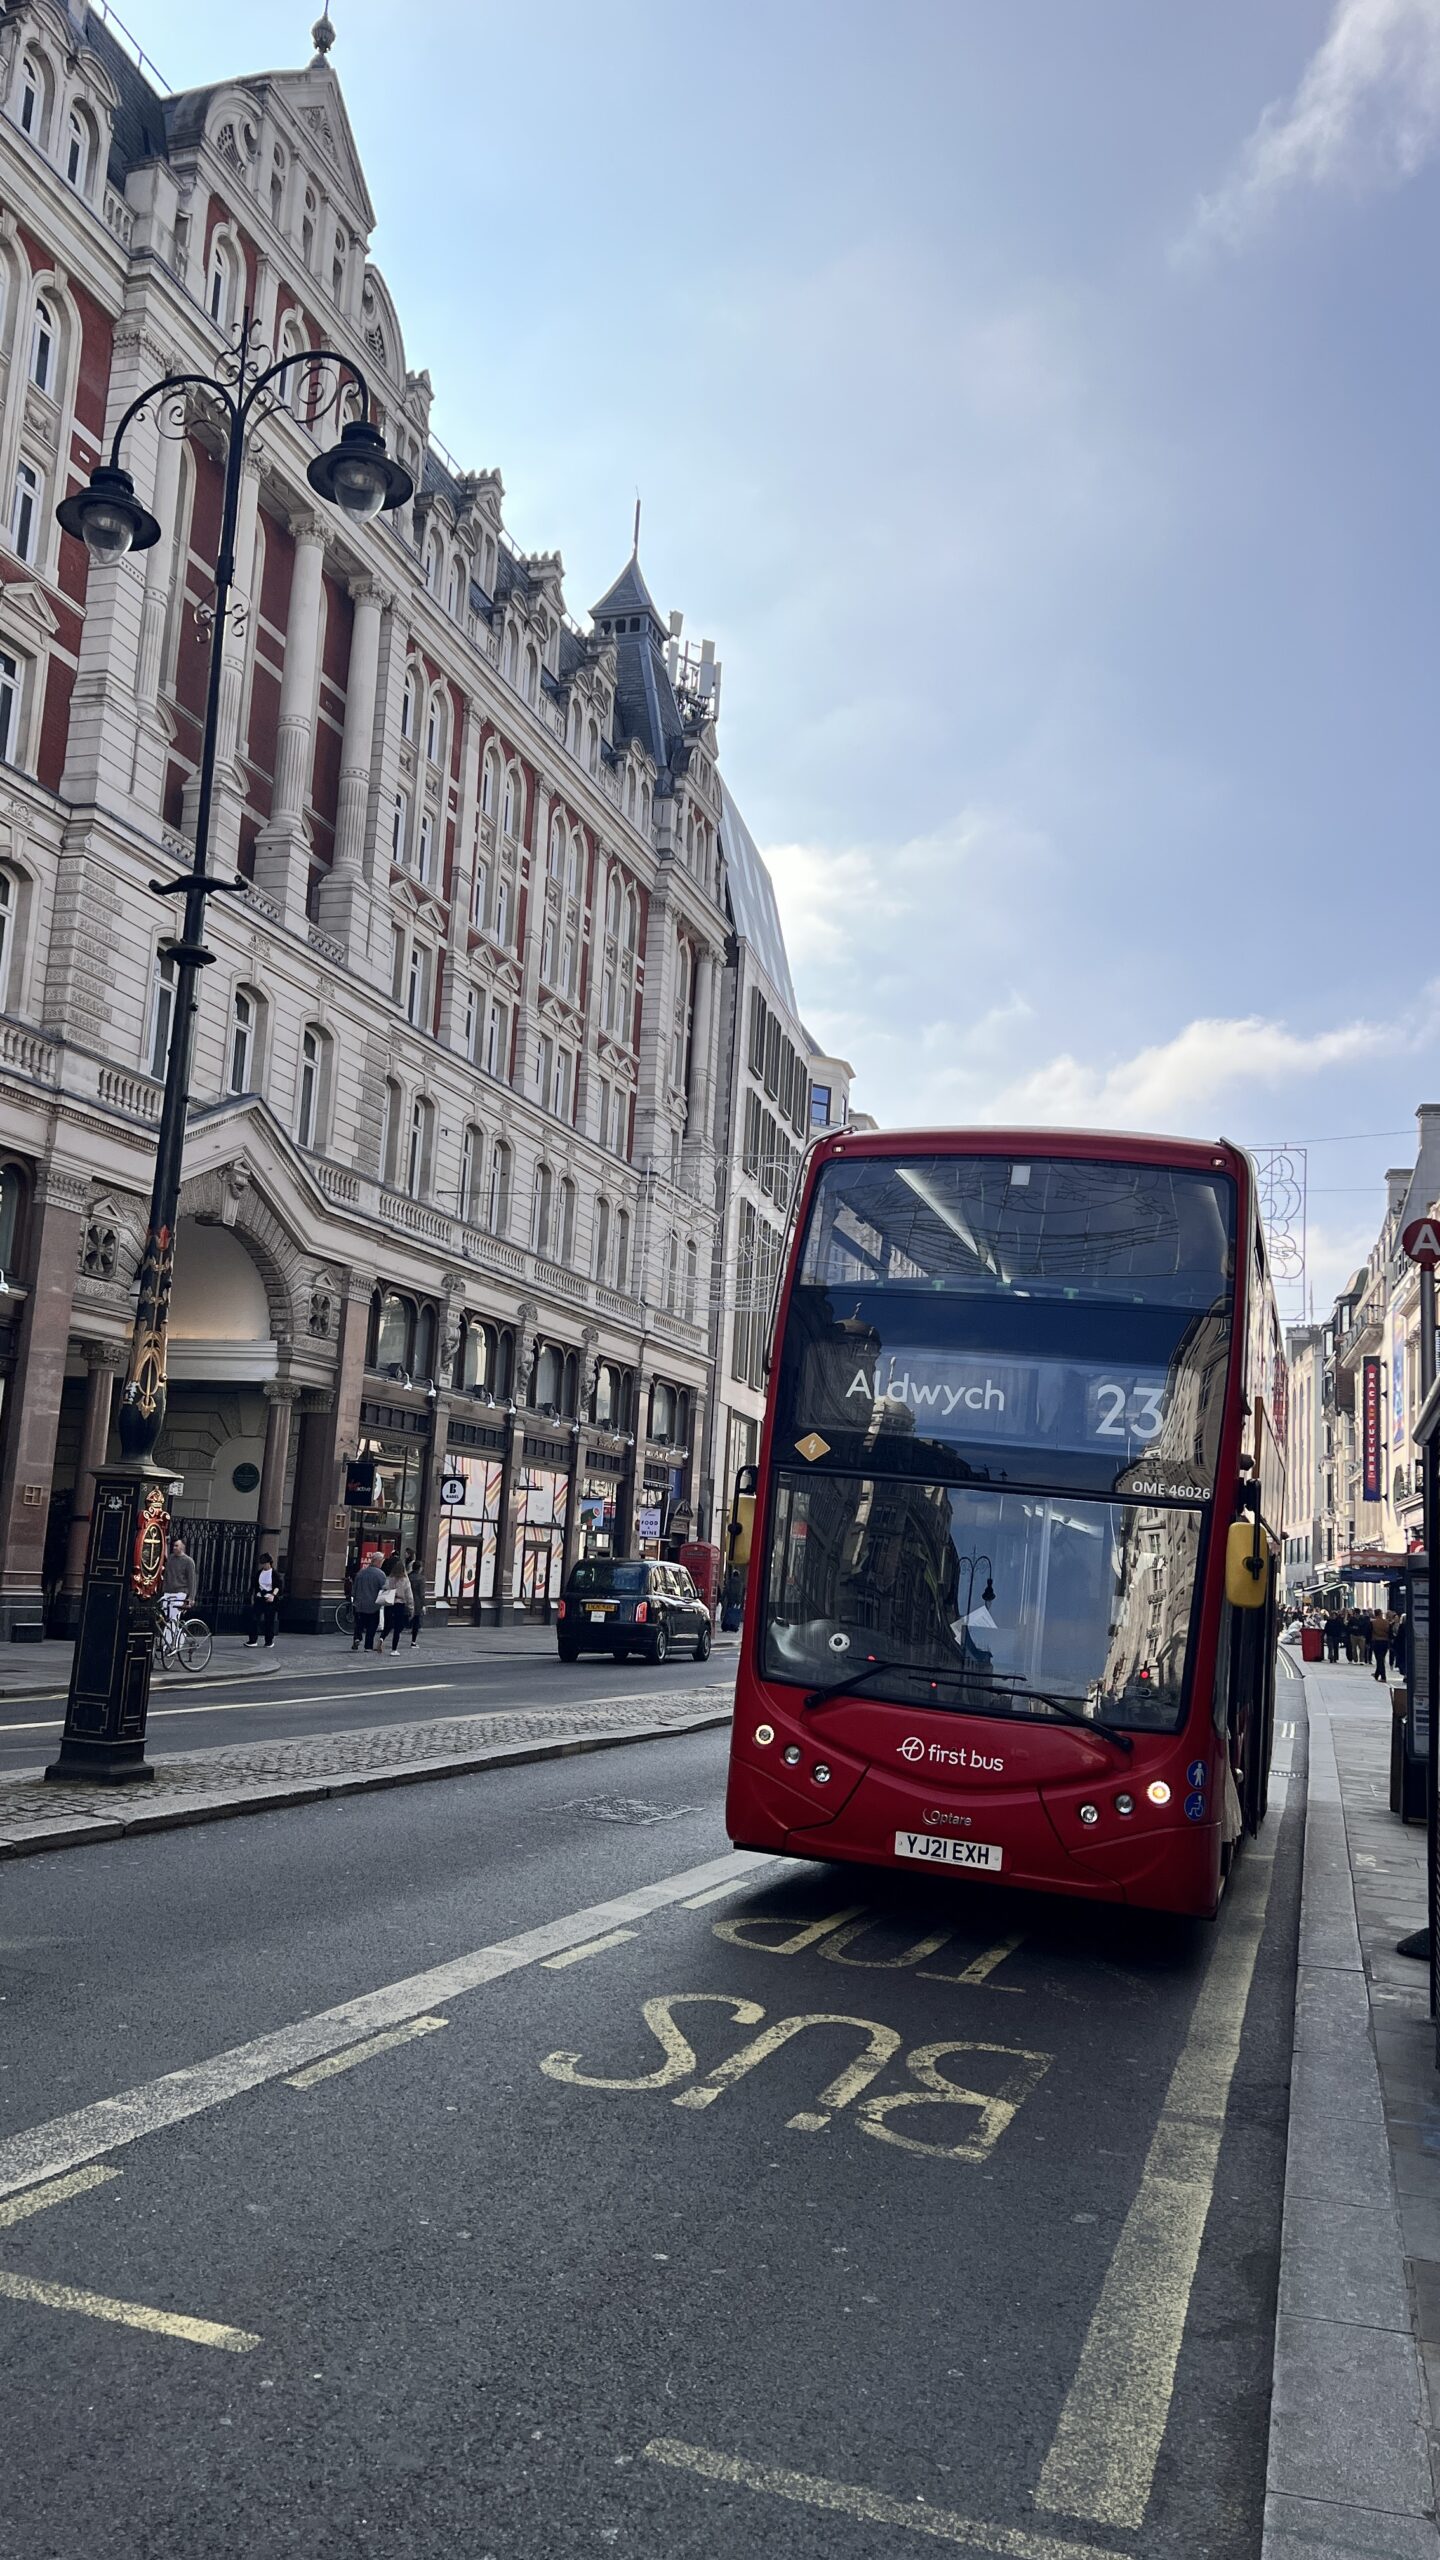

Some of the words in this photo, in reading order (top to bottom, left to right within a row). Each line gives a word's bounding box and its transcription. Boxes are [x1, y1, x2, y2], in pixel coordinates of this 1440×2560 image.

[1411, 1223, 1440, 1256] A
[846, 1369, 1005, 1416] Aldwych
[1095, 1383, 1165, 1439] 23
[1368, 1372, 1376, 1406] BACK
[1368, 1419, 1376, 1471] FUTURE
[1132, 1480, 1165, 1496] OME
[1168, 1482, 1211, 1500] 46026
[928, 1744, 967, 1766] first
[969, 1750, 1004, 1772] bus
[929, 1810, 972, 1826] Optare
[907, 1835, 947, 1859] YJ21
[952, 1842, 989, 1865] EXH
[711, 1904, 1028, 1994] TOP
[538, 1993, 1057, 2165] BUS
